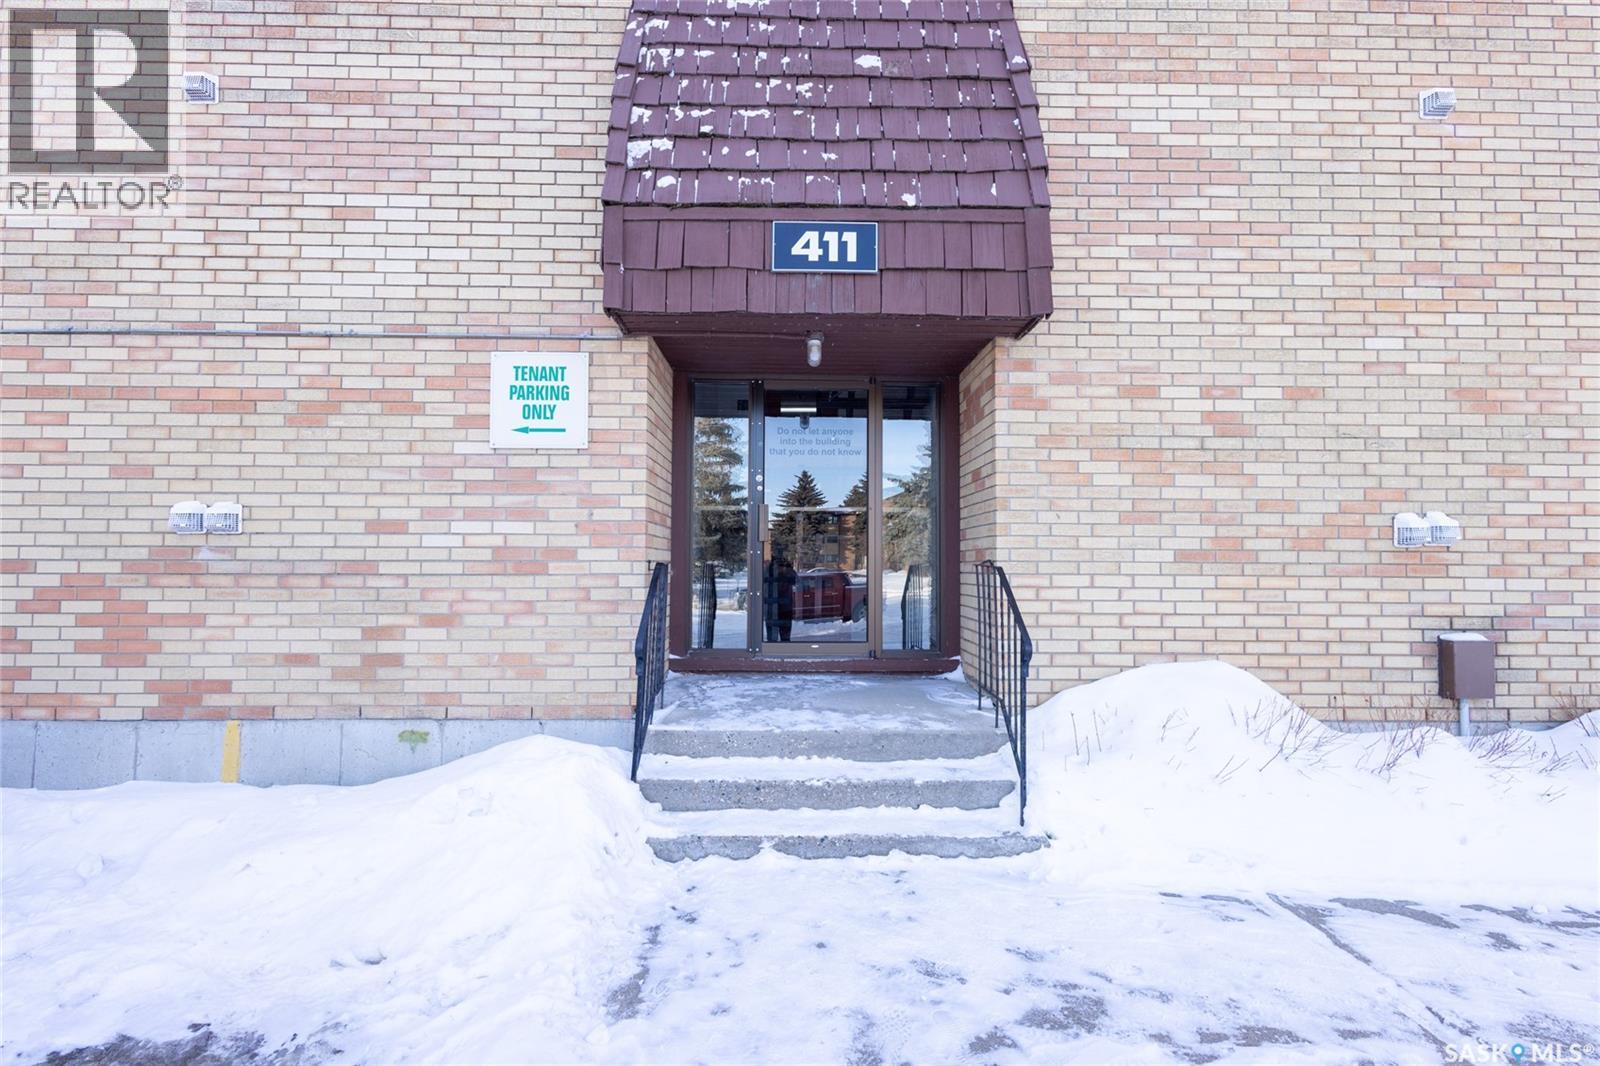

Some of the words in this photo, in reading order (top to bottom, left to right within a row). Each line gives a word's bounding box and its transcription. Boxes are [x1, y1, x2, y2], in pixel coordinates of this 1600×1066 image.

[791, 230, 857, 262] 411
[513, 365, 567, 382] TENANT
[509, 384, 570, 401] PARKING
[522, 404, 556, 420] ONLY
[777, 426, 790, 436] Do
[791, 426, 807, 436] not
[808, 426, 821, 436] let
[821, 427, 855, 438] anyone
[780, 436, 798, 446] into
[799, 436, 814, 446] the
[815, 436, 852, 447] building
[769, 447, 787, 456] that
[788, 448, 806, 457] you
[807, 447, 820, 456] do
[820, 447, 836, 456] not
[837, 447, 863, 456] know
